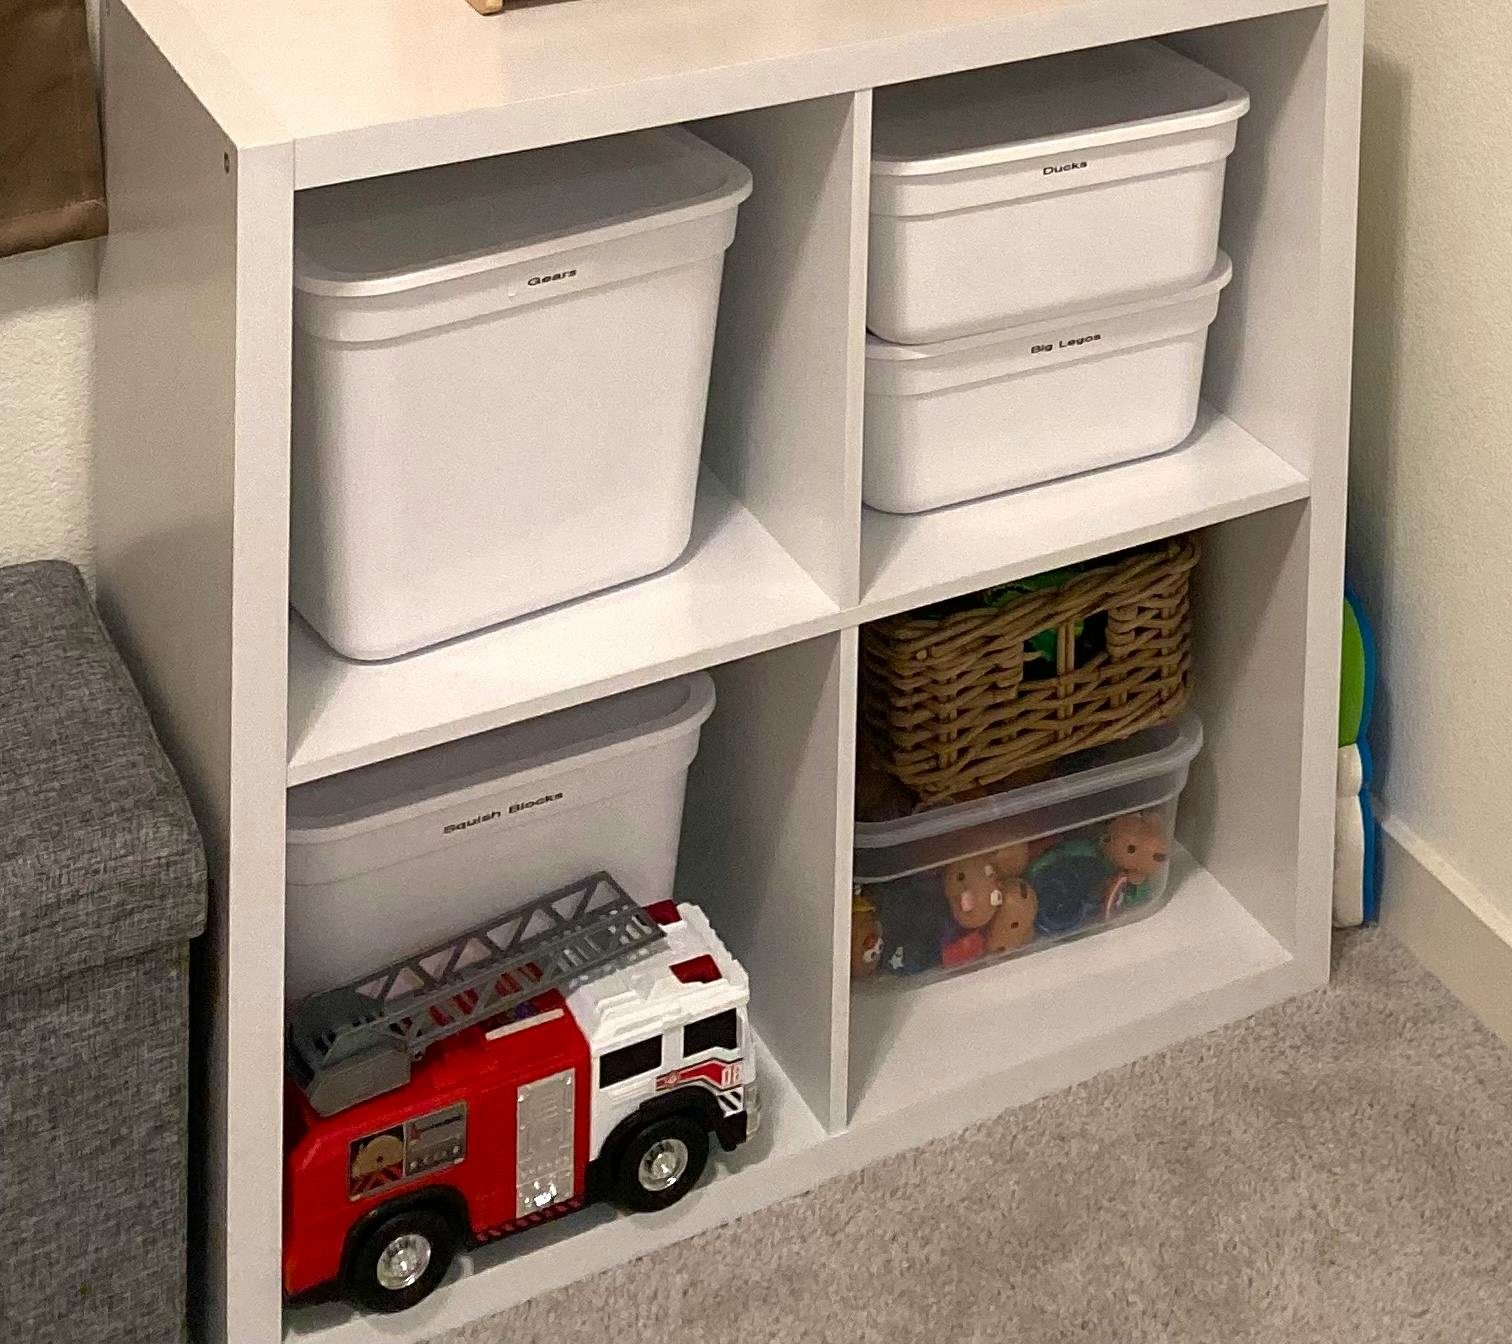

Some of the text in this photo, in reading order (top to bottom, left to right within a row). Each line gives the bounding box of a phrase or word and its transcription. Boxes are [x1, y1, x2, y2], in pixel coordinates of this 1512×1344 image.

[1042, 161, 1088, 176] Ducks
[527, 269, 577, 287] Gears
[1030, 333, 1102, 354] Big Legos
[442, 792, 564, 834] Squish Blocks
